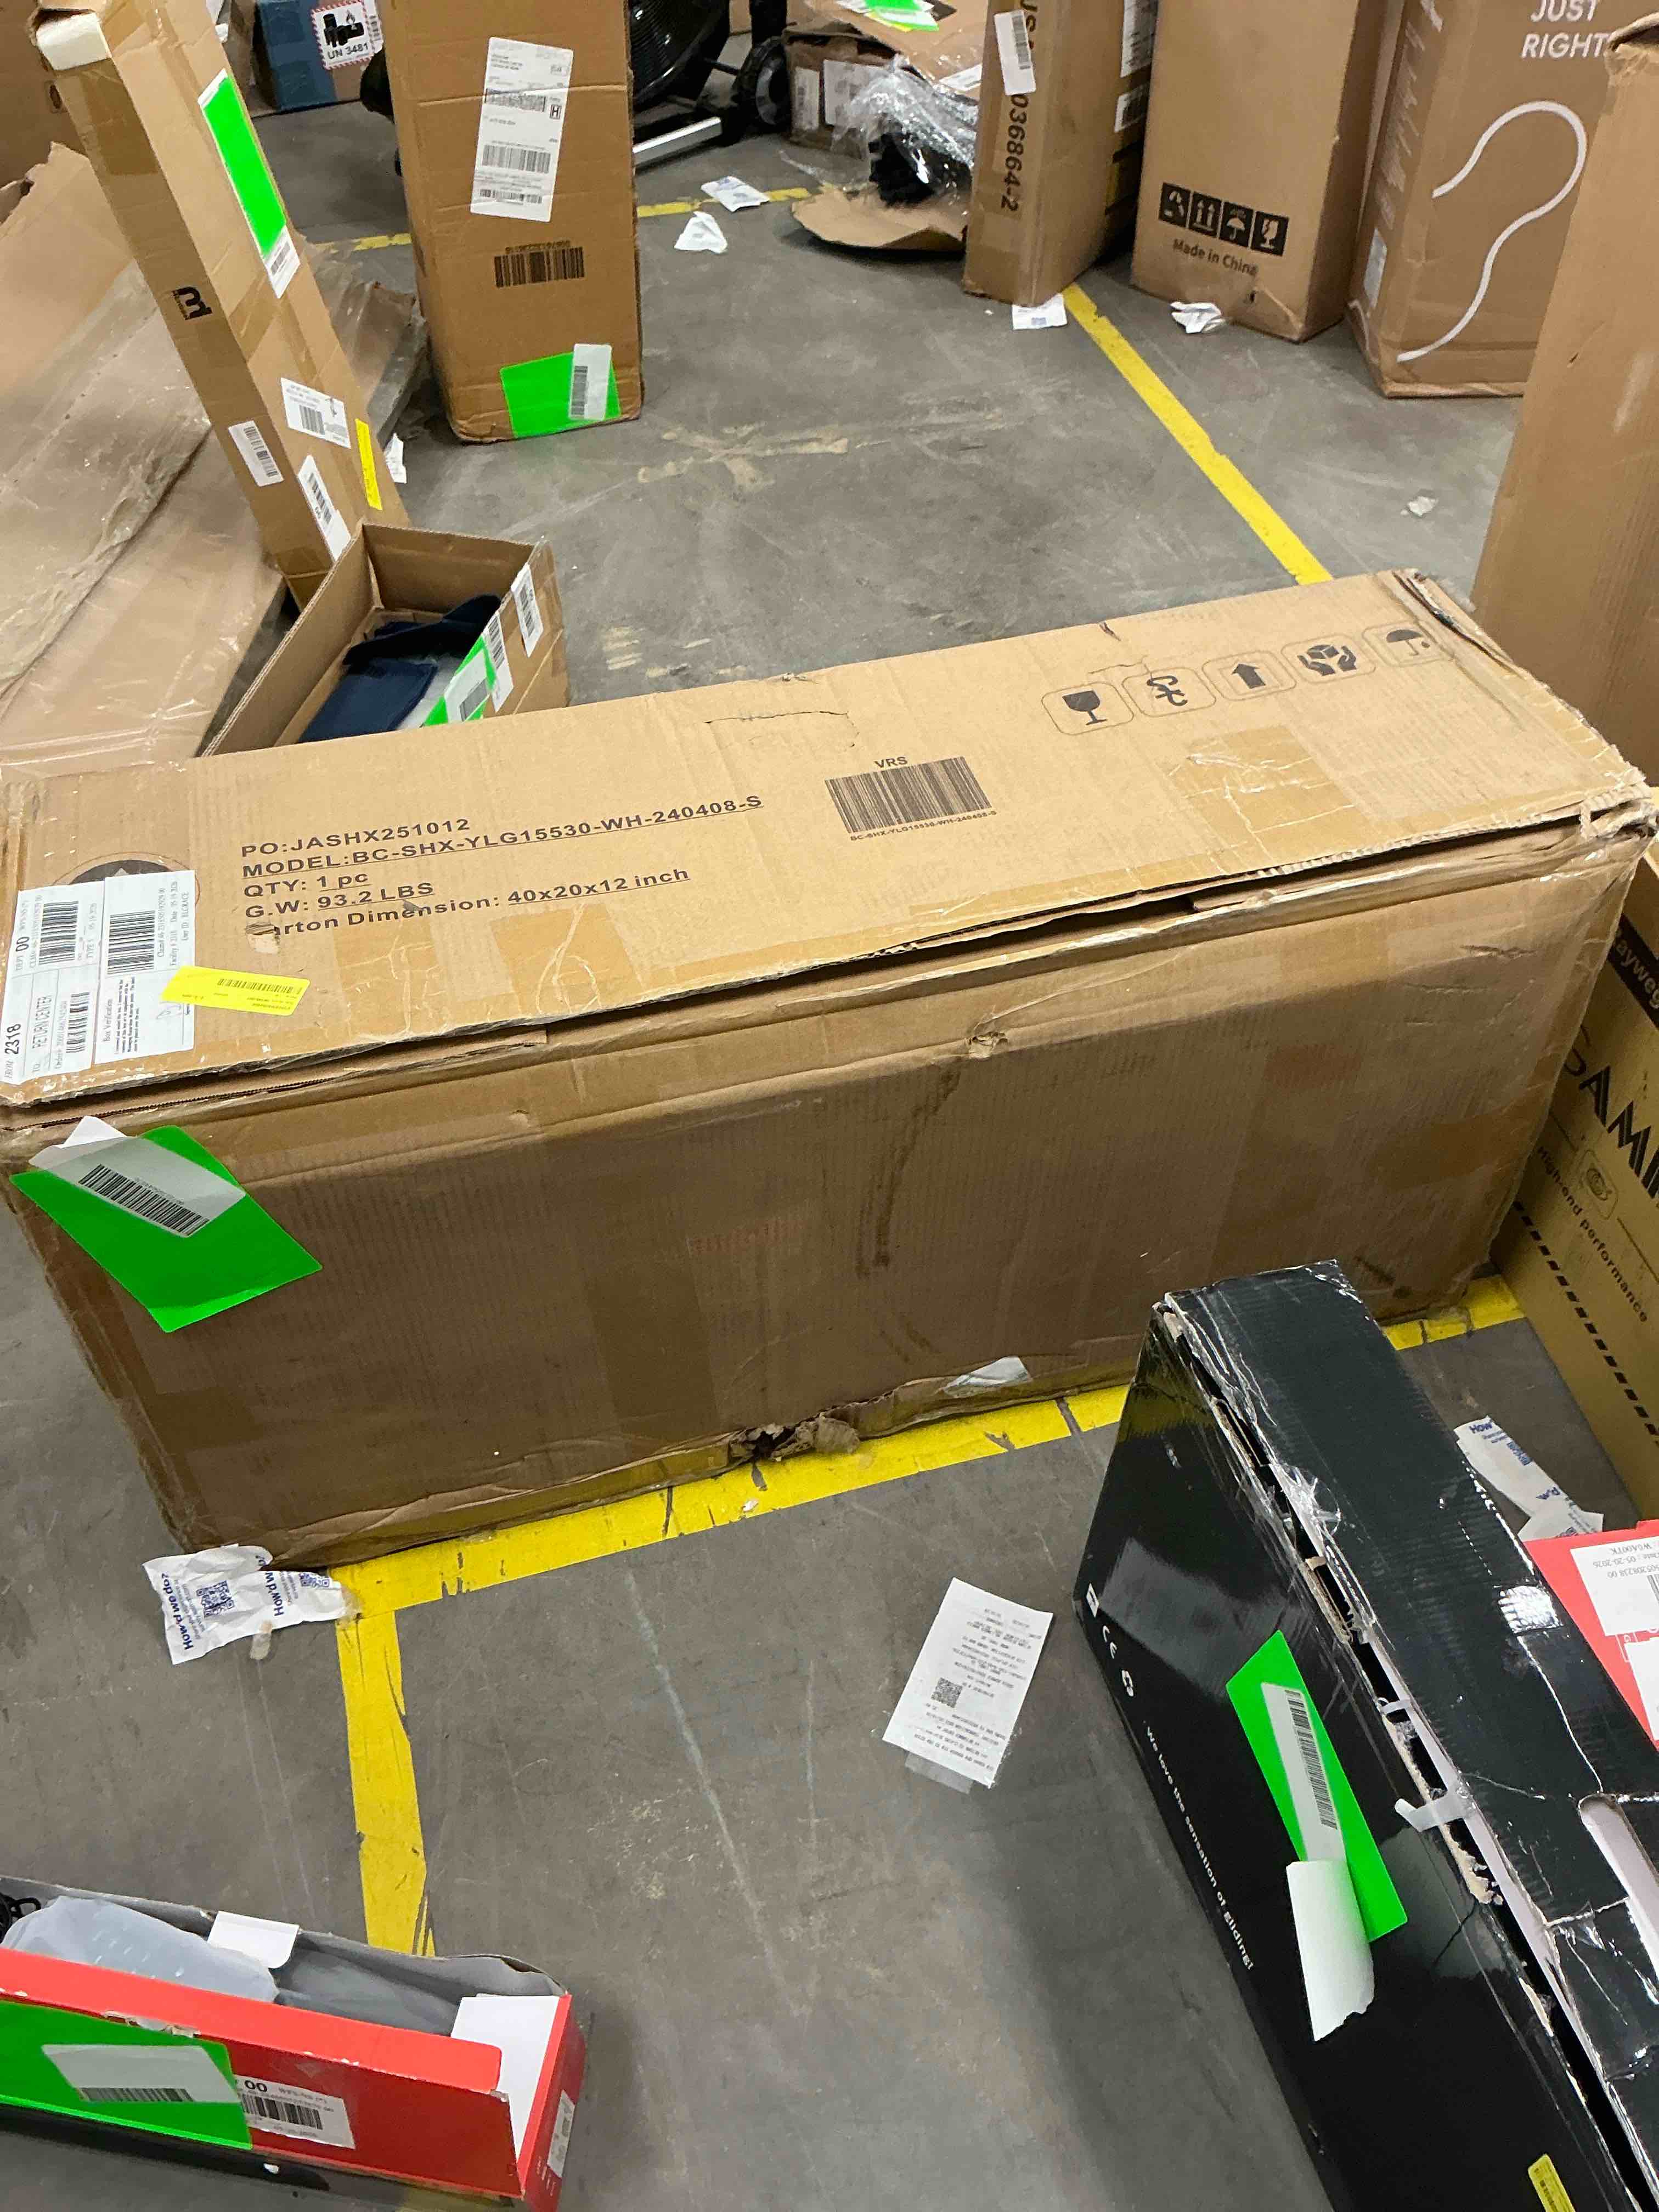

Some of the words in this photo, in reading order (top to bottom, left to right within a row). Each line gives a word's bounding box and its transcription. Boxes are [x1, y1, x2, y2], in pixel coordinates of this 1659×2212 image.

[328, 48, 343, 59] UN
[345, 43, 368, 55] 3481
[1173, 239, 1205, 259] Made
[1208, 249, 1220, 263] in
[874, 756, 908, 768] VRS
[241, 818, 470, 857] PO:JASHX251012
[242, 795, 762, 878] MODEL:BC-SHX-YLG15530-WH-240408-S
[244, 878, 307, 898] QTY:
[316, 876, 327, 888] 1
[337, 873, 369, 889] pc
[245, 899, 308, 918] G.W:
[318, 891, 373, 909] 93.2
[381, 882, 433, 900] LBS
[347, 896, 499, 926] Dimension:
[507, 878, 629, 902] 40x20x12
[634, 868, 690, 888] inch
[15, 936, 30, 952] 00
[35, 995, 53, 1021] CENTER
[4, 1024, 21, 1054] 2318
[32, 1020, 49, 1049] RETURN
[1579, 1218, 1647, 1323] performance
[161, 1573, 173, 1594] do?
[168, 1595, 179, 1612] we
[266, 1583, 284, 1616] How'd
[173, 1614, 194, 1650] How'd
[1159, 1754, 1173, 1785] love
[1173, 1787, 1186, 1813] the
[1186, 1816, 1217, 1888] sensation
[1217, 1891, 1227, 1906] of
[245, 2080, 267, 2092] 00
